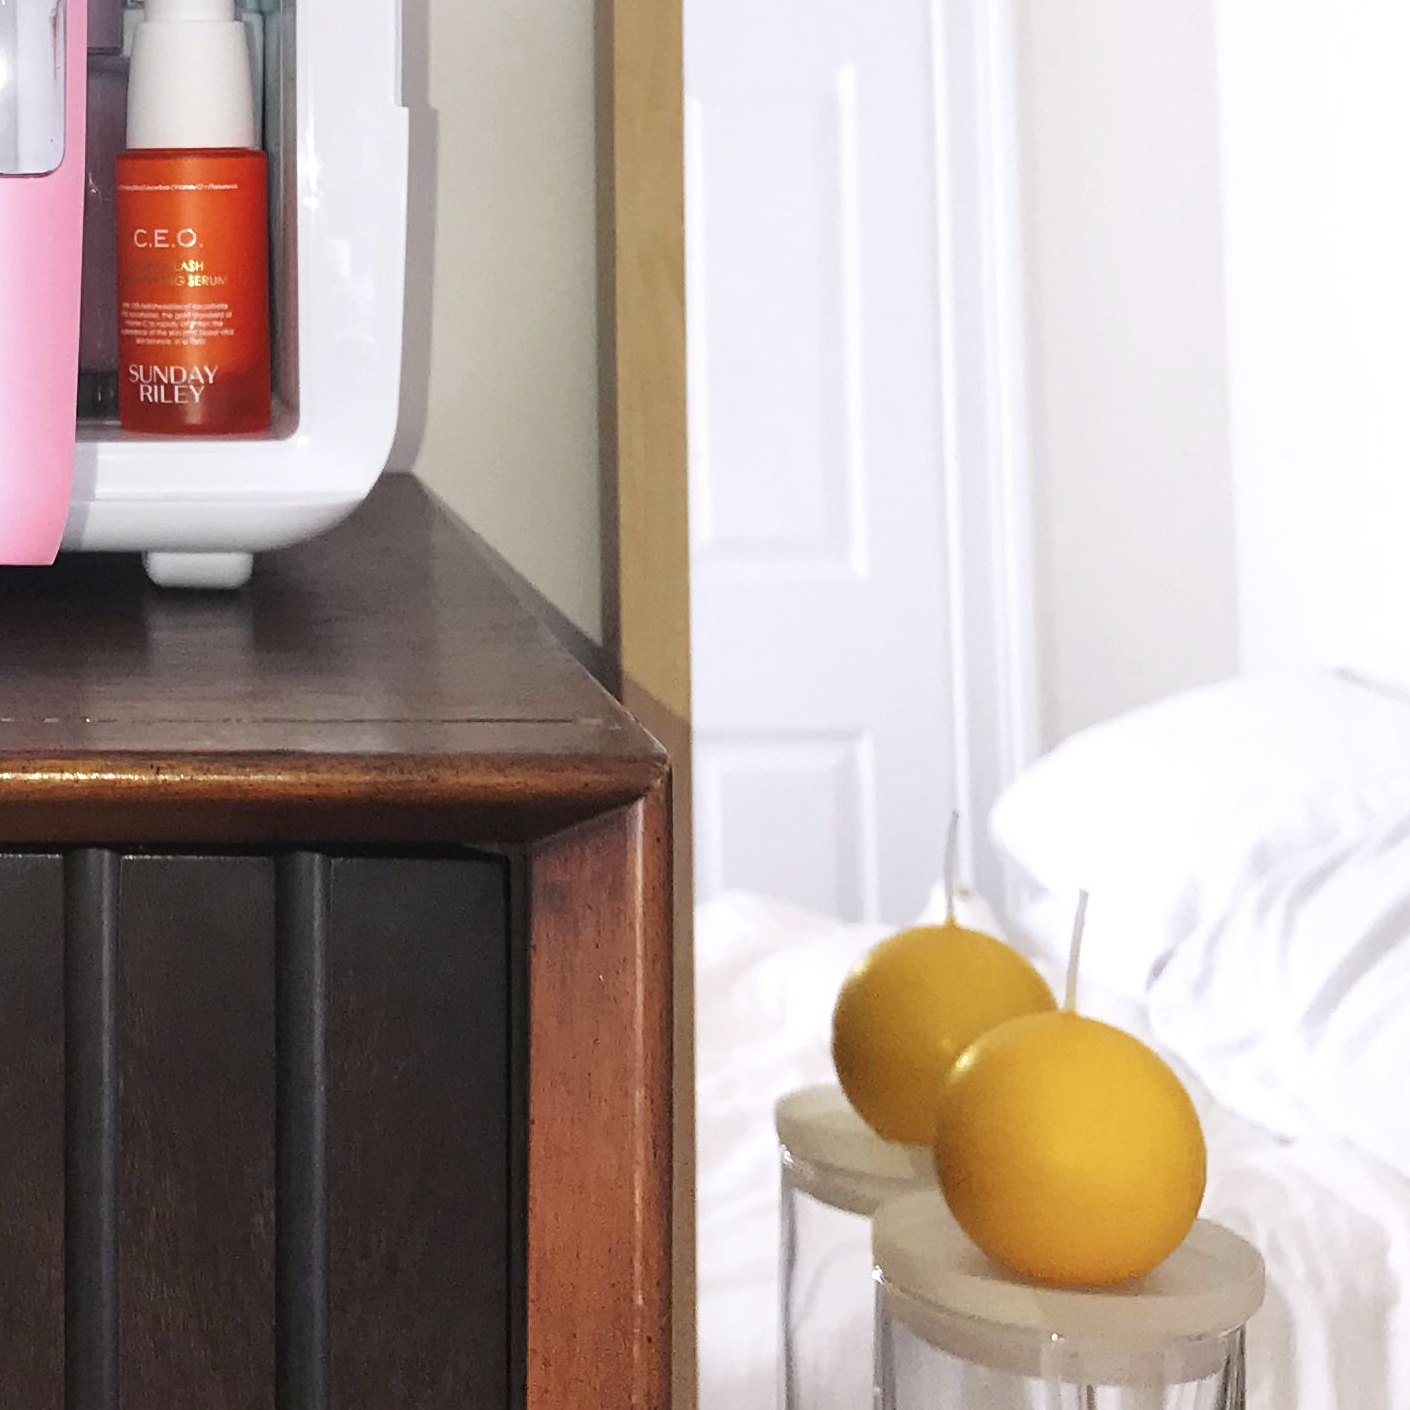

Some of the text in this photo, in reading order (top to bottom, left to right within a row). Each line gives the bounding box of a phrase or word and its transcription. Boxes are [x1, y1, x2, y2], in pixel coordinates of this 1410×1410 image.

[133, 228, 204, 248] C.E.O.
[187, 274, 227, 288] SERUM
[128, 365, 218, 385] SUNDAY
[140, 385, 205, 404] RILEY
